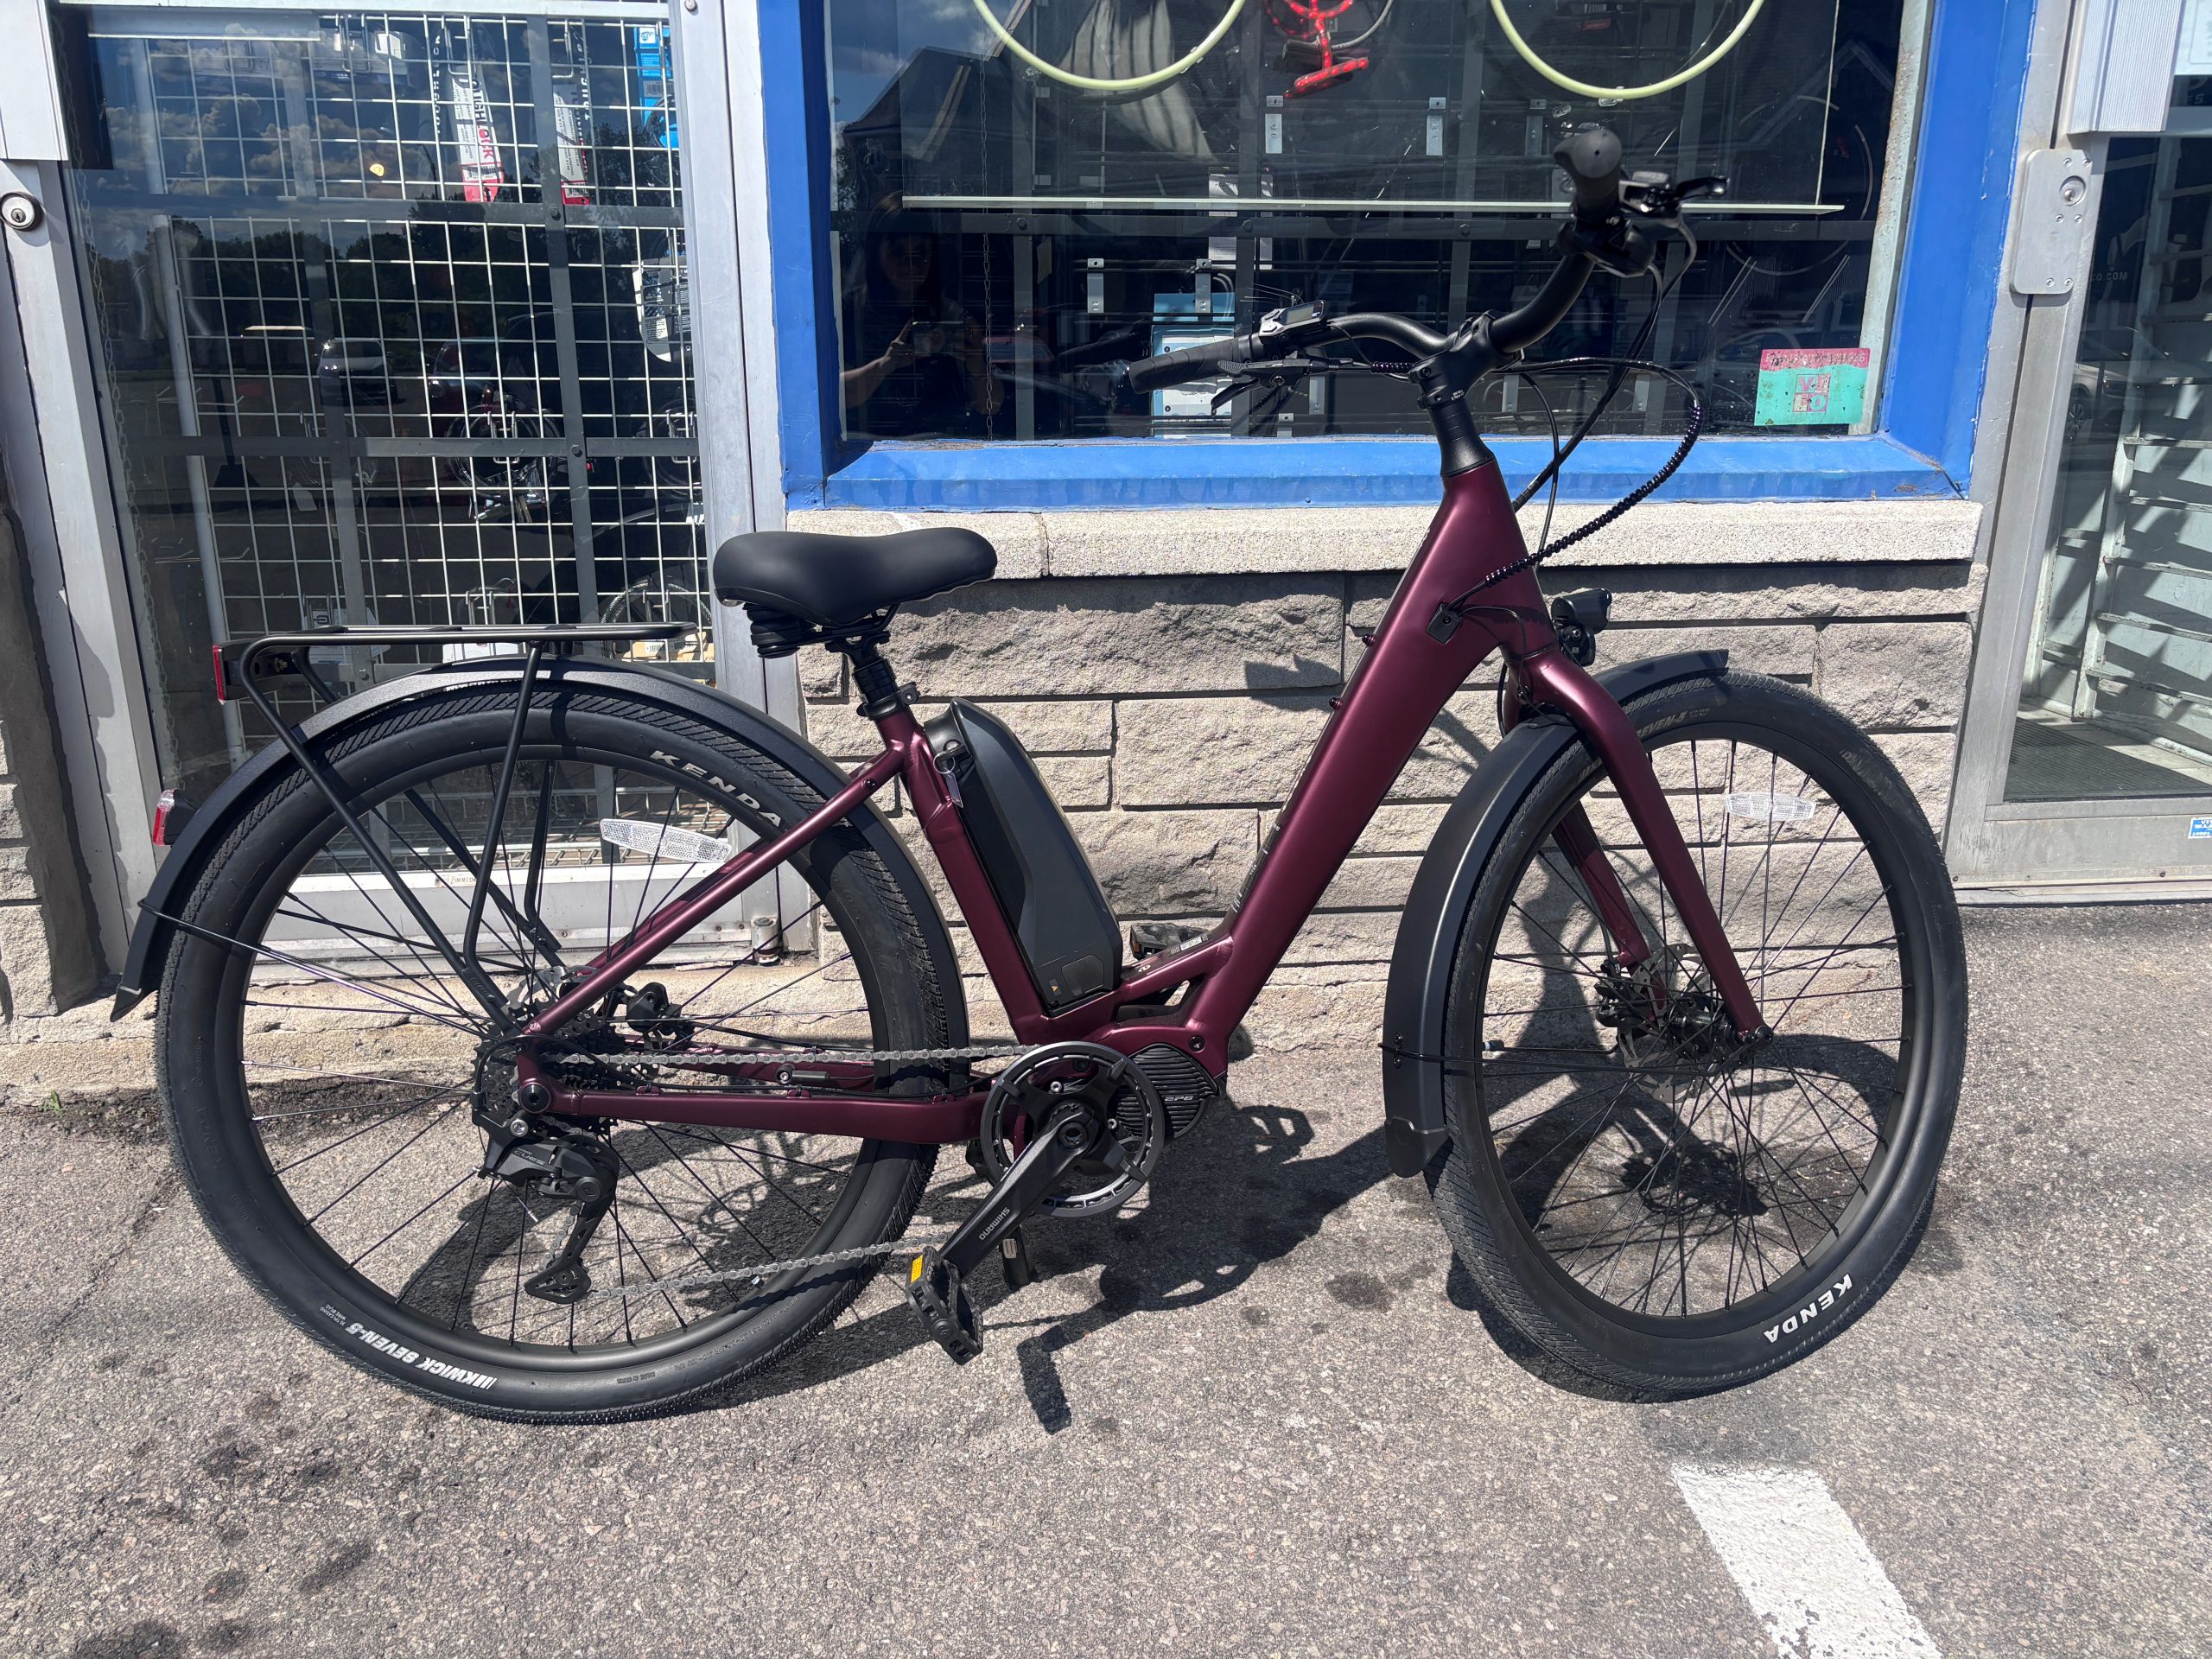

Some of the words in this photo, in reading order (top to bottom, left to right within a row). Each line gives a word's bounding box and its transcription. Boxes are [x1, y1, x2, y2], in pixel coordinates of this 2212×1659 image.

[650, 750, 781, 828] KENDA
[978, 1206, 1010, 1241] SHIMANO
[1763, 1273, 1853, 1344] KENDA
[344, 1322, 420, 1364] SEVEN-5
[416, 1357, 478, 1385] KWICK
